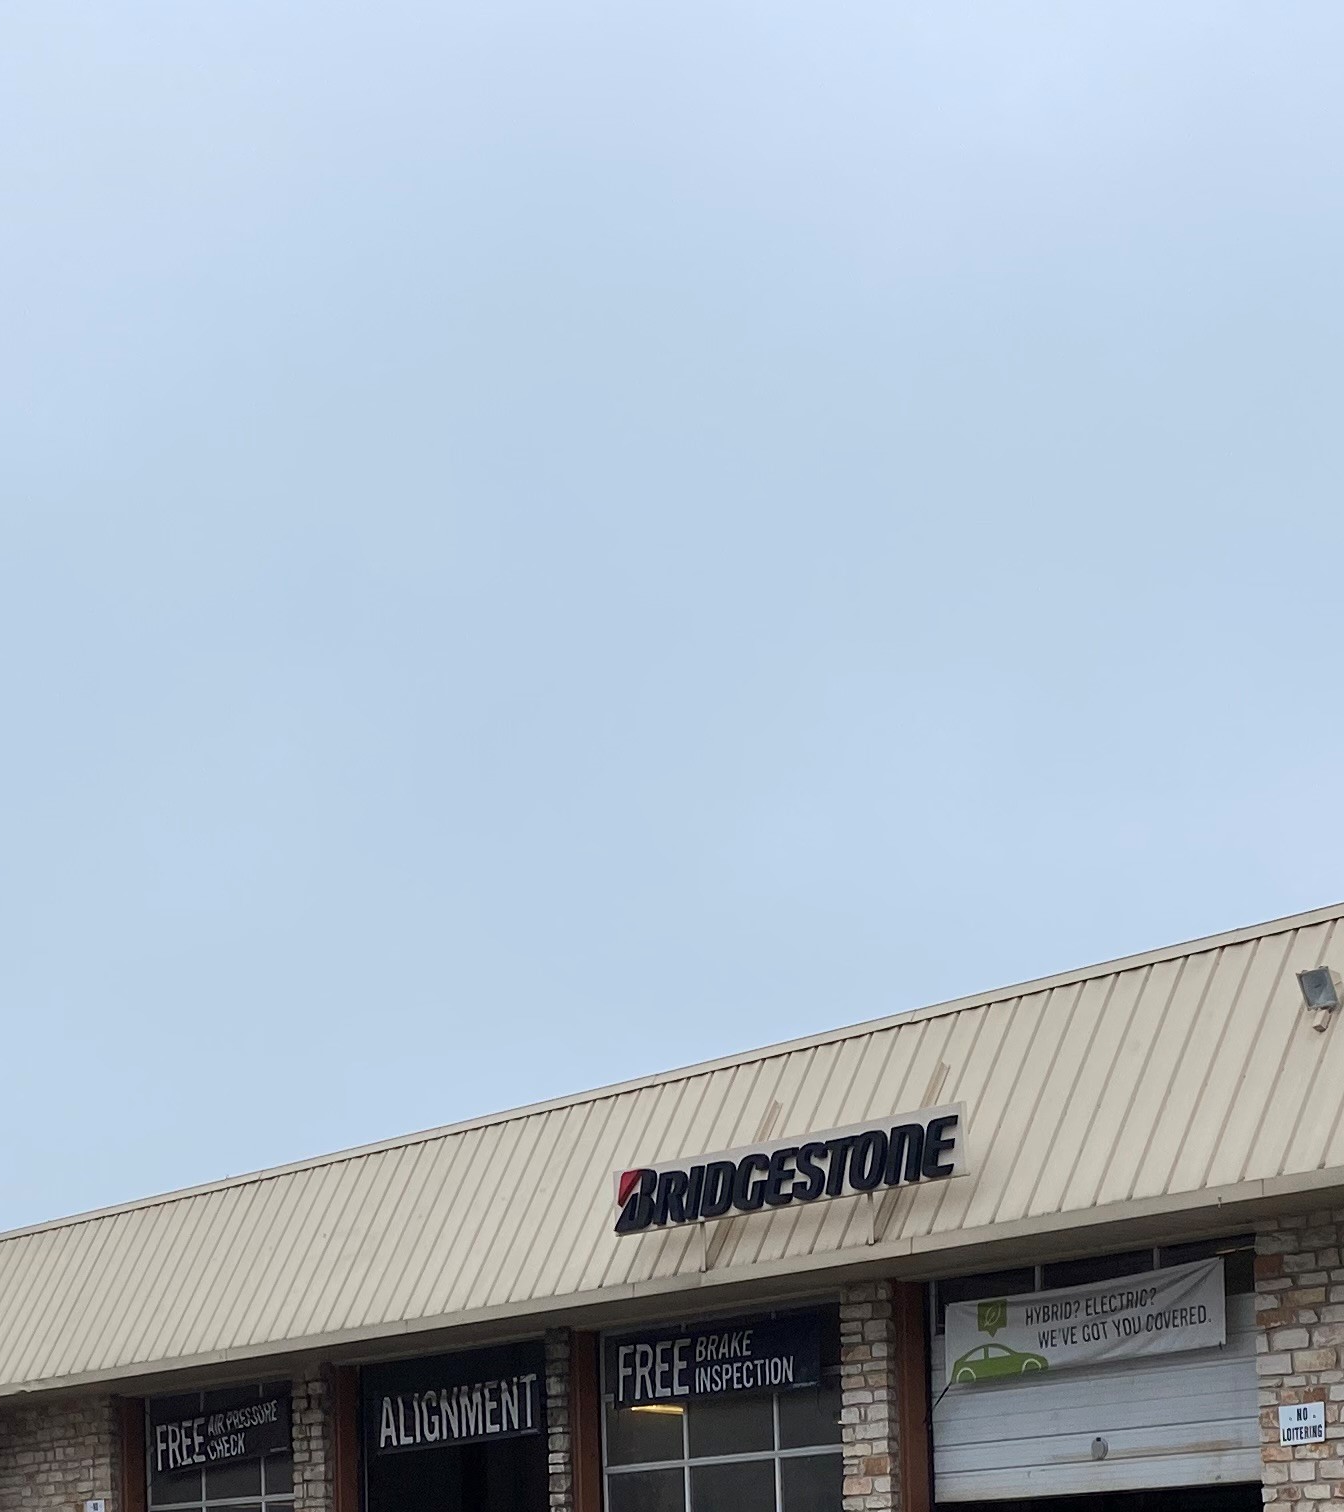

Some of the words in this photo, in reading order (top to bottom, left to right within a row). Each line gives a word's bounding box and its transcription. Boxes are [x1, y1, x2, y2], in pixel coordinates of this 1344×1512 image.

[614, 1114, 958, 1233] BRIDGESTONE
[1025, 1303, 1081, 1326] HYBRID?
[1085, 1287, 1157, 1317] ELECTRIC?
[695, 1330, 754, 1362] BRAKE
[1038, 1327, 1078, 1349] WE'VE
[1082, 1324, 1108, 1342] GOT
[1112, 1319, 1139, 1338] YOU
[1145, 1305, 1212, 1333] COVERED.
[618, 1338, 690, 1402] FREE
[695, 1356, 795, 1394] INSPECTION
[207, 1413, 225, 1438] AIR
[226, 1400, 278, 1432] PRESSURE
[379, 1373, 538, 1449] ALIGNMENT
[1297, 1407, 1309, 1422] NO
[156, 1417, 206, 1472] FREE
[207, 1432, 246, 1461] CHECK
[1282, 1424, 1323, 1443] LOITERING
